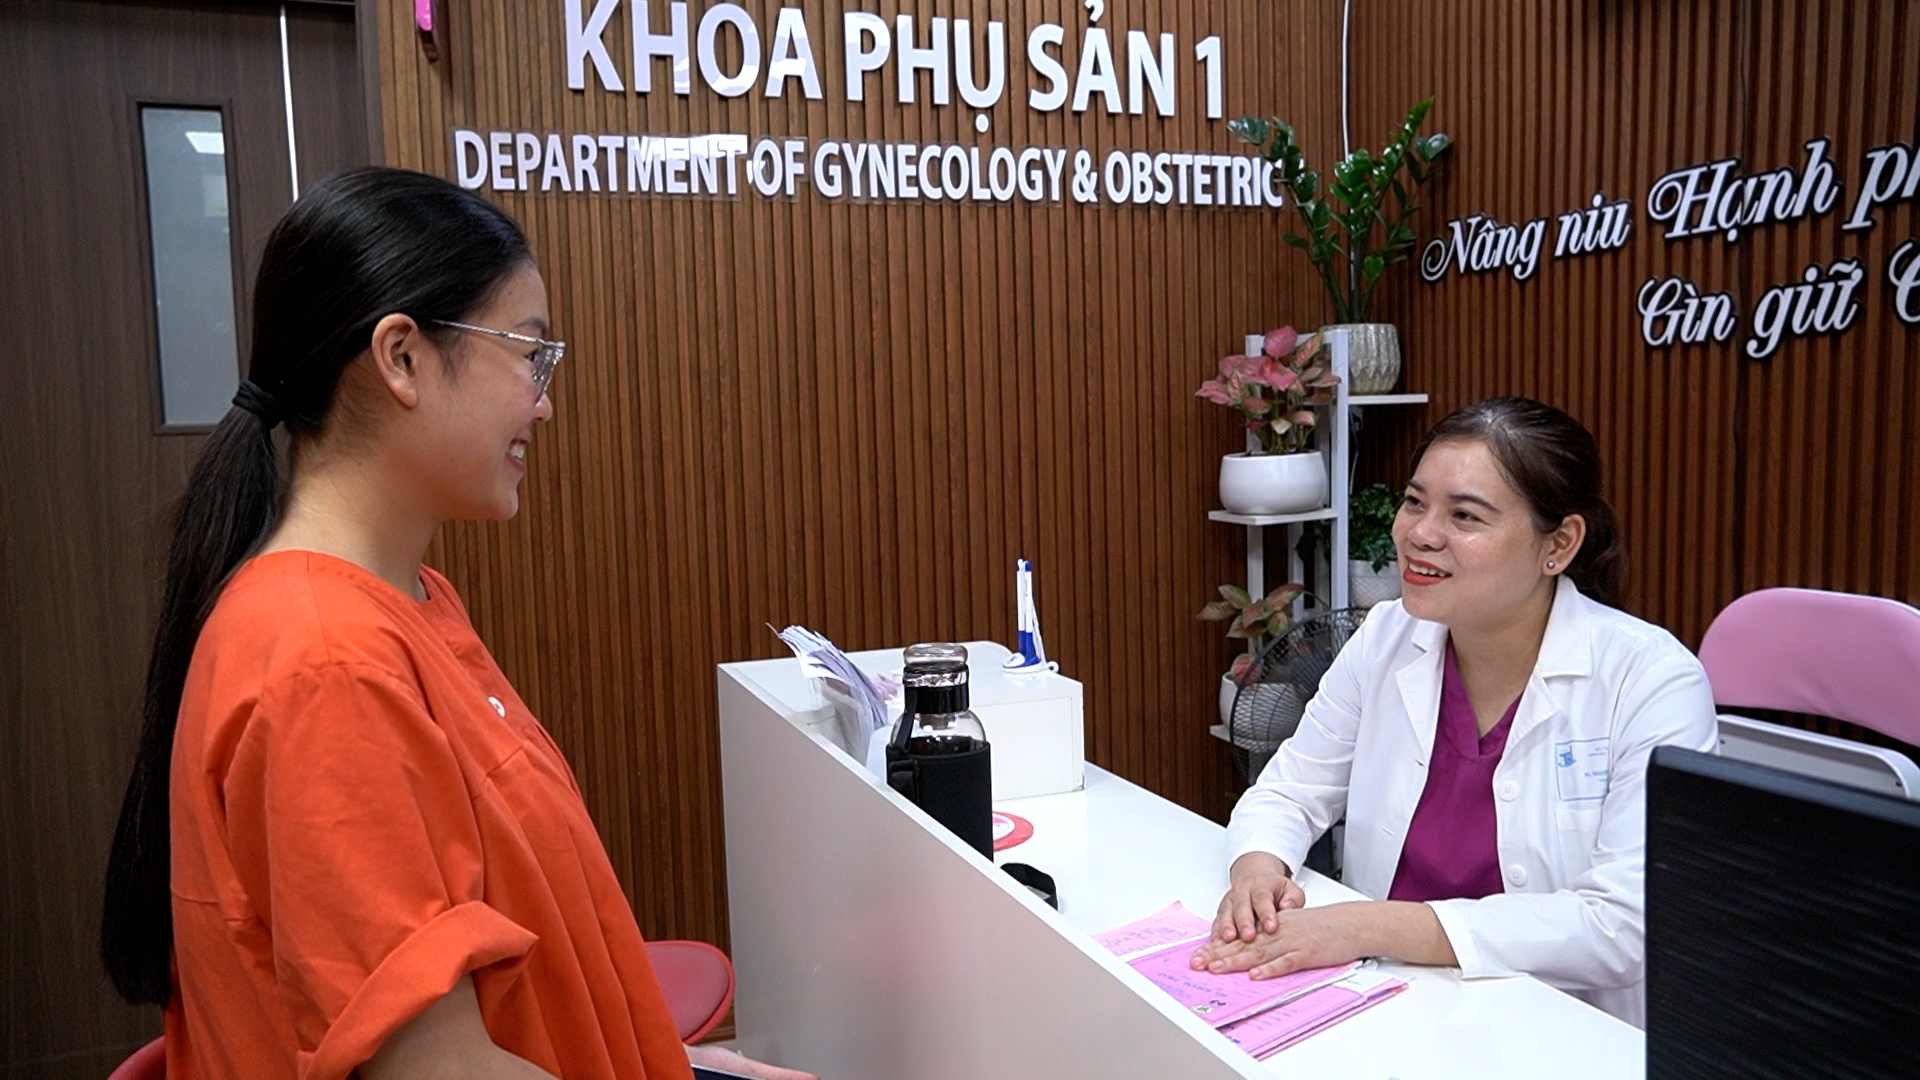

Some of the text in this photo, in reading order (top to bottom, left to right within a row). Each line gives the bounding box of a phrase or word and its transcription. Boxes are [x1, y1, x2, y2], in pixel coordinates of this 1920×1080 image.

[565, 0, 1223, 133] KHOA PHỤ SẢN 1
[454, 130, 748, 195] DEPARTMENT
[752, 138, 805, 198] OF
[814, 141, 1067, 201] GYNECOLOGY
[1071, 149, 1099, 204] &
[1421, 213, 1546, 282] Nâng
[1554, 193, 1632, 258] niu
[1648, 137, 1839, 244] Hạnh
[1637, 276, 1737, 347] Gìn
[1746, 259, 1864, 359] giữ
